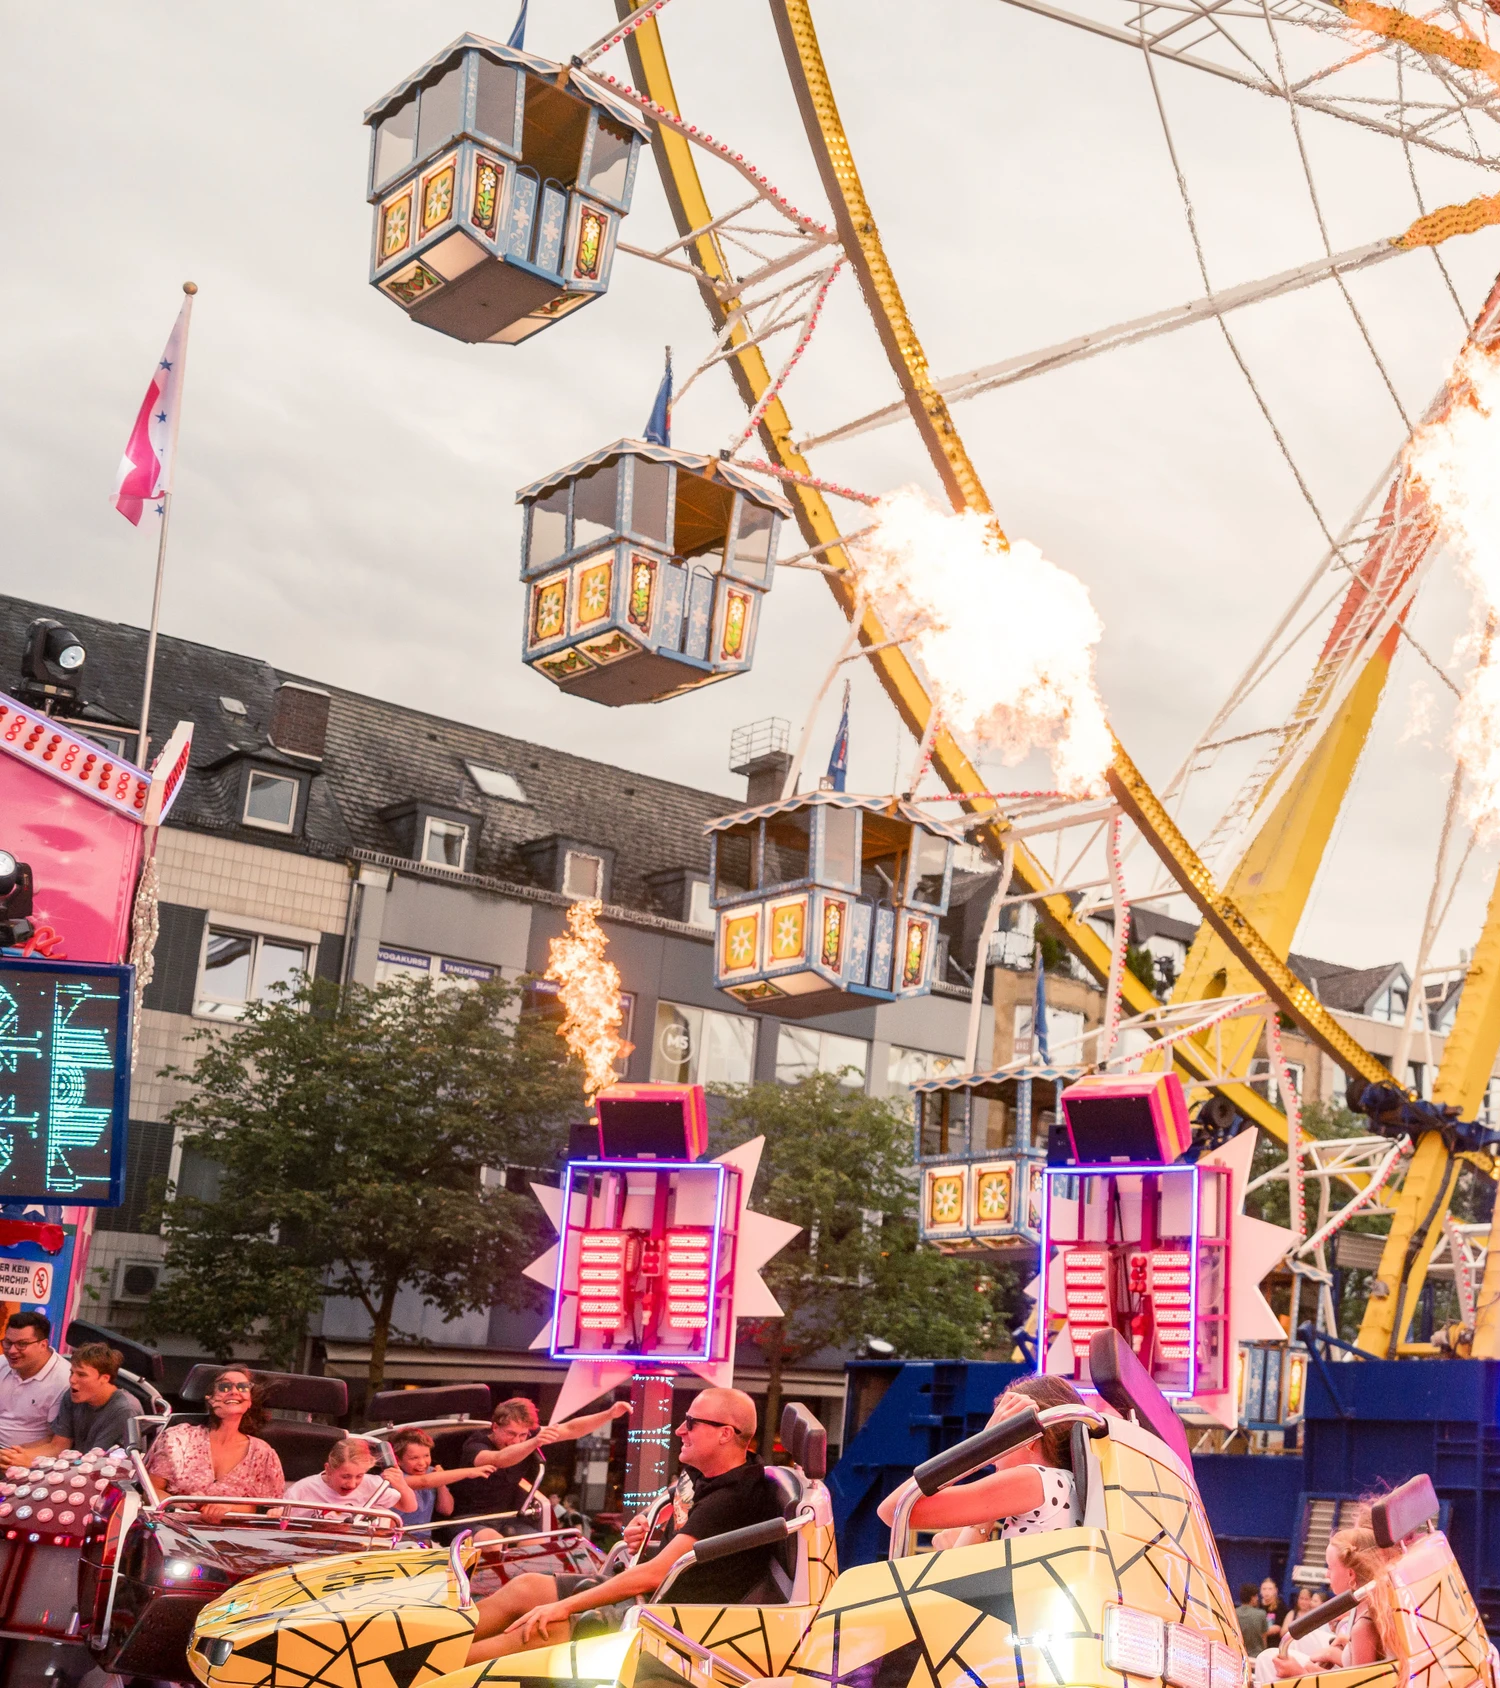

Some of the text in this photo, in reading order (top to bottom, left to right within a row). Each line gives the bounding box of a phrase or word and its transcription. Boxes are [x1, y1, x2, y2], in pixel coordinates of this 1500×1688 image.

[378, 951, 428, 968] YOGAKURSE
[444, 963, 490, 980] TANZKURSE
[11, 1264, 30, 1274] KEIN
